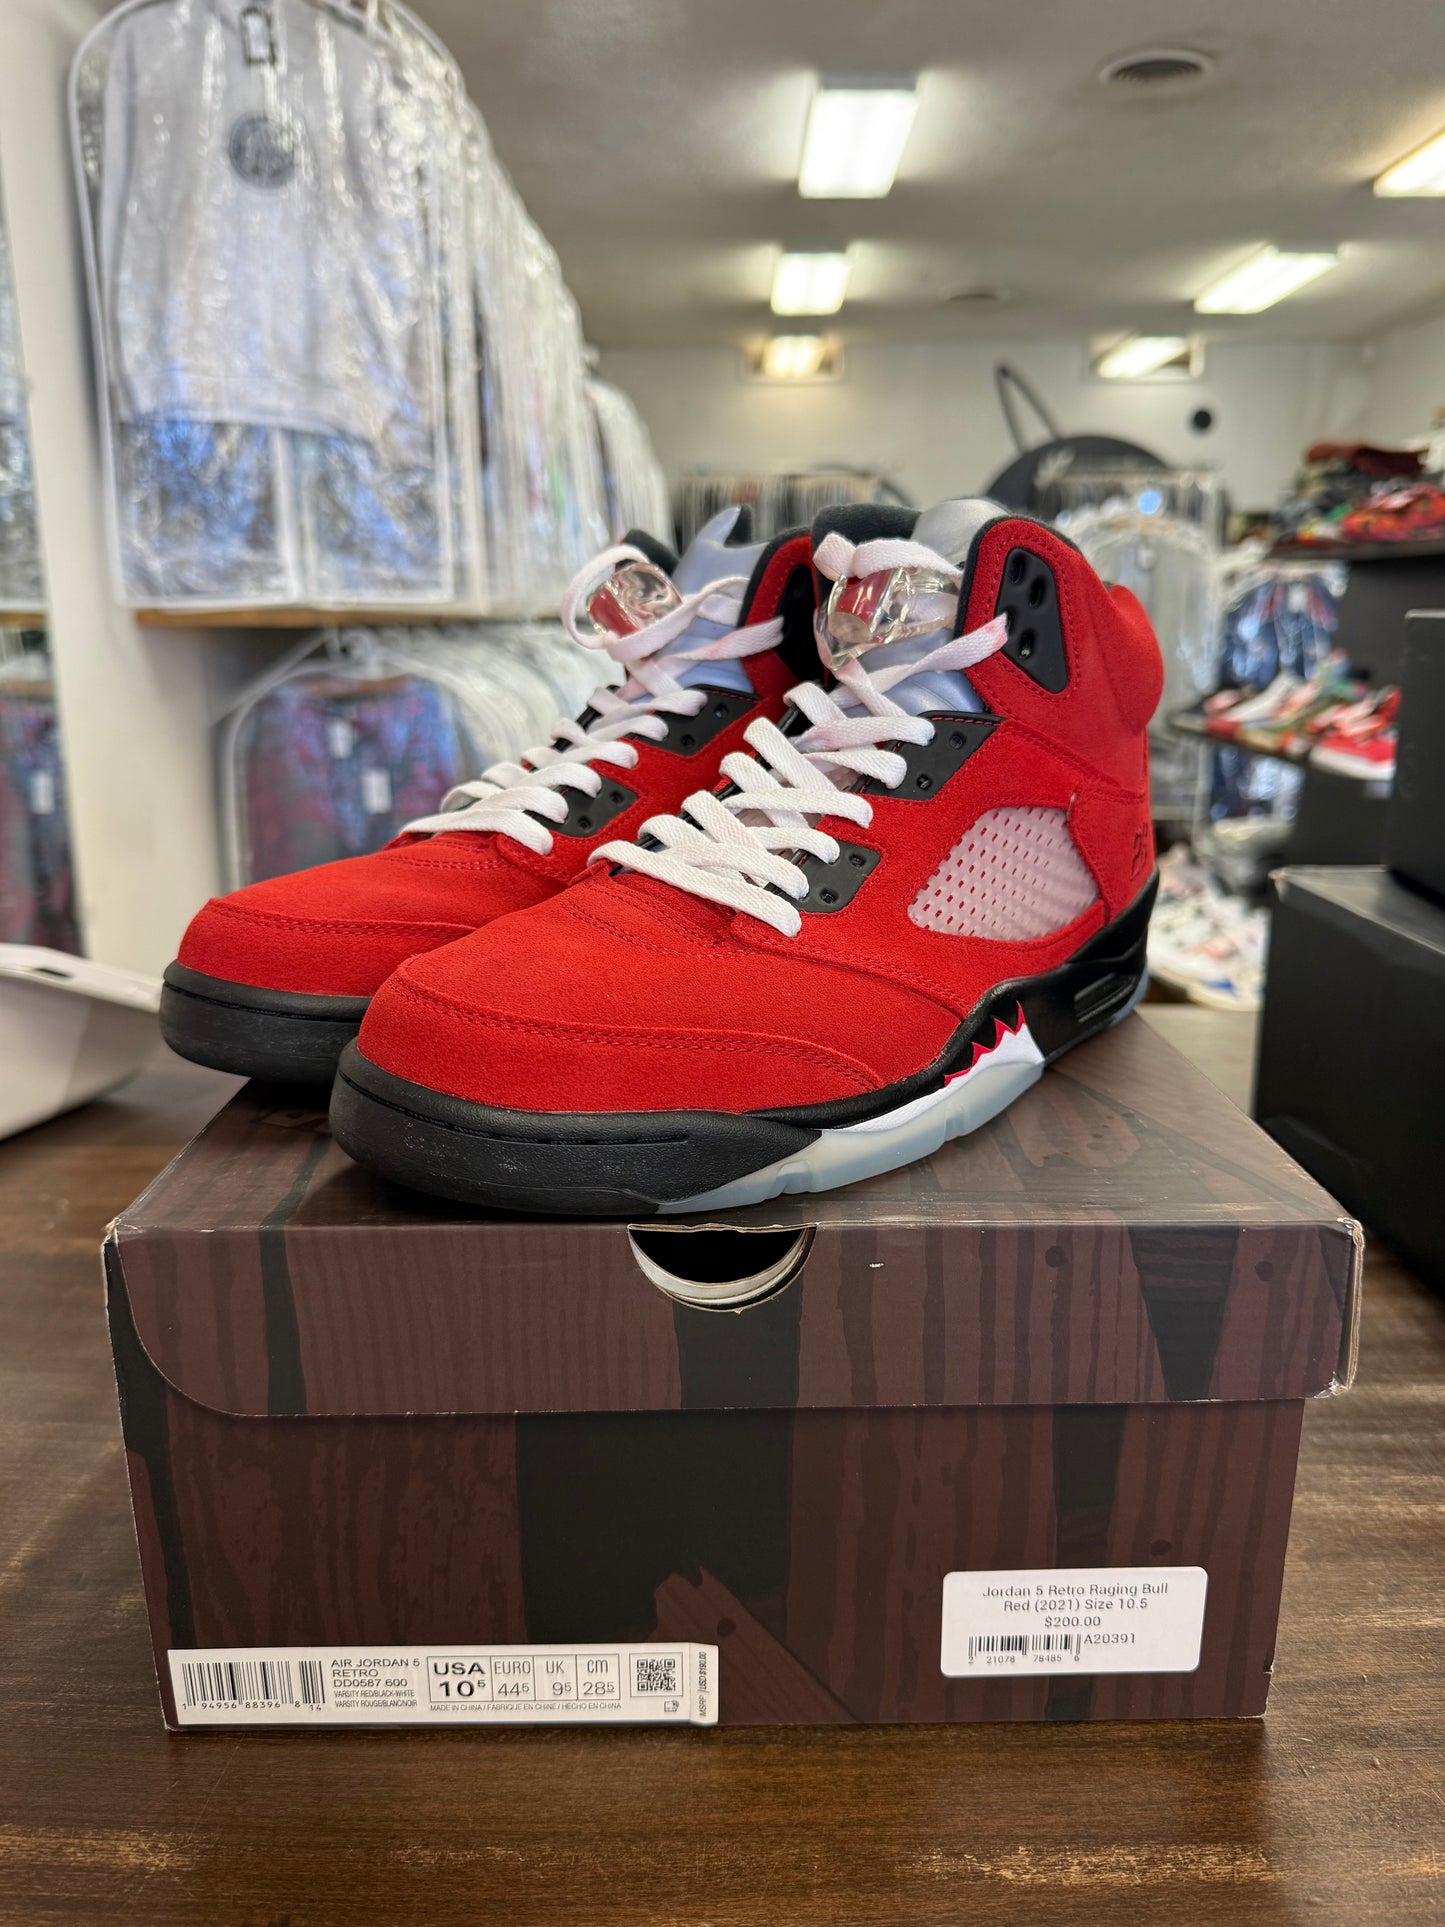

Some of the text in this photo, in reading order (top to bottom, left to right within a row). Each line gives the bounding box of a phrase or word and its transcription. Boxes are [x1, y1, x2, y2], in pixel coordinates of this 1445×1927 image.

[983, 1583, 1168, 1597] Jordan 5 Retro Raging Bull
[1004, 1598, 1148, 1612] Red (2021) Size 10.5
[1044, 1615, 1101, 1628] $200.00
[1083, 1633, 1136, 1644] A20391
[331, 1659, 352, 1667] AIR
[356, 1659, 408, 1667] JORDAN
[986, 1655, 1015, 1664] 21078
[333, 1669, 378, 1677] RETRO
[434, 1662, 486, 1675] USA
[494, 1660, 530, 1674] EURO
[546, 1660, 565, 1674] UK
[334, 1679, 380, 1687] DD0587
